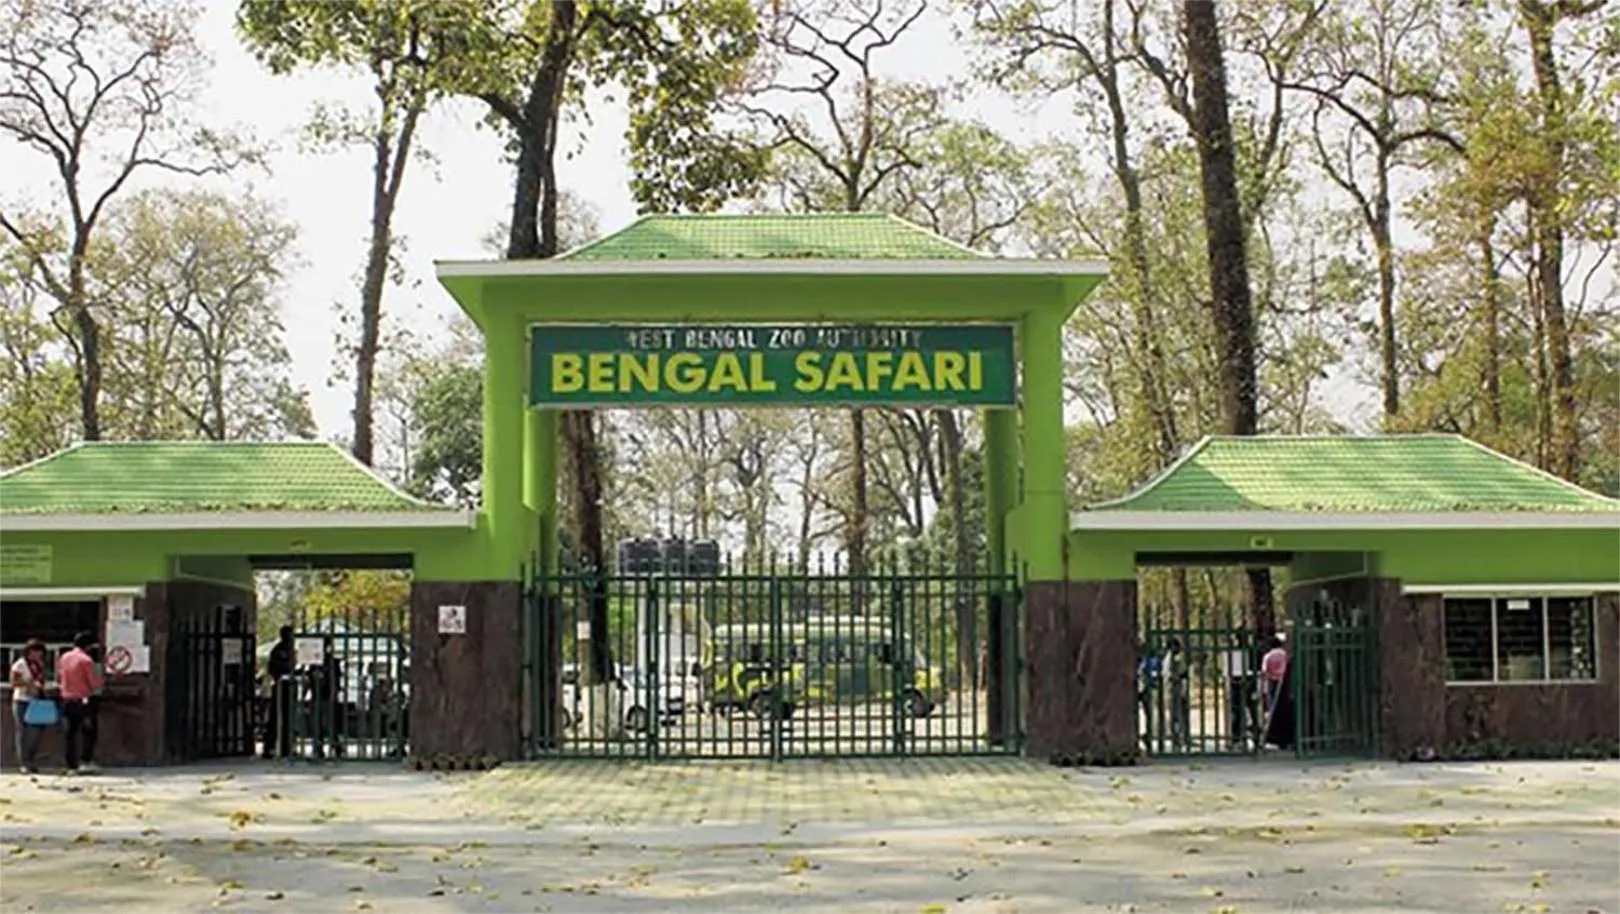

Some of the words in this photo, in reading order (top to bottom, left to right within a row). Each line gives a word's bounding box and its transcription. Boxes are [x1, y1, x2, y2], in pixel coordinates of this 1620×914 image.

[685, 329, 757, 349] BENGAL
[768, 329, 806, 349] ZOO
[552, 352, 776, 393] BENGAL
[794, 351, 983, 392] SAFARI
